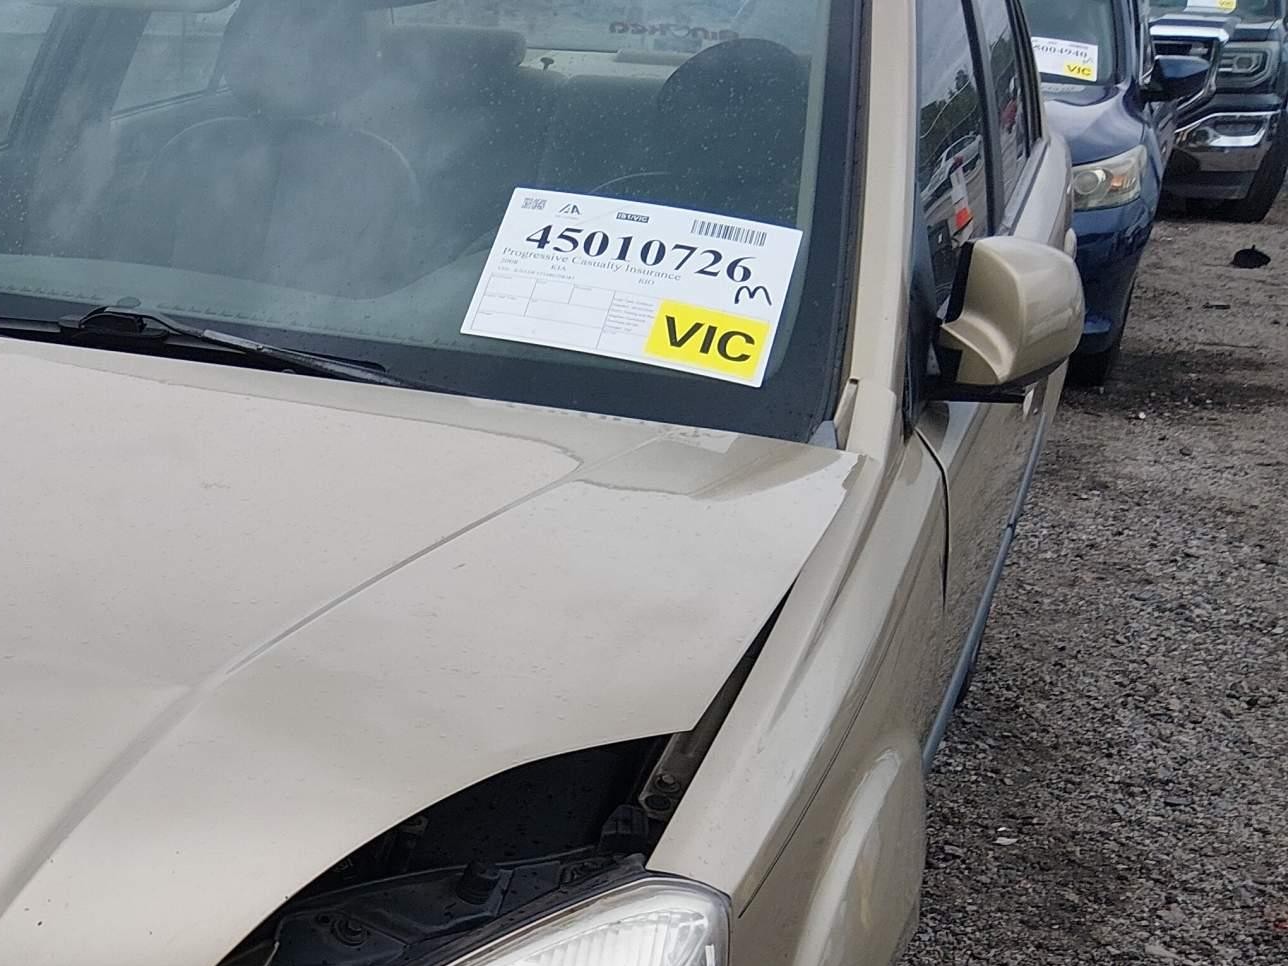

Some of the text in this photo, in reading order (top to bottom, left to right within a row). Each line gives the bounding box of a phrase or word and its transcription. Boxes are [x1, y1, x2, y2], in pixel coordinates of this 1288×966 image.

[1066, 64, 1092, 77] VIC
[502, 246, 569, 263] Progressive
[571, 256, 624, 273] Casualty
[624, 263, 681, 282] Insurance
[525, 224, 757, 283] 45010726
[664, 315, 756, 363] VIC
